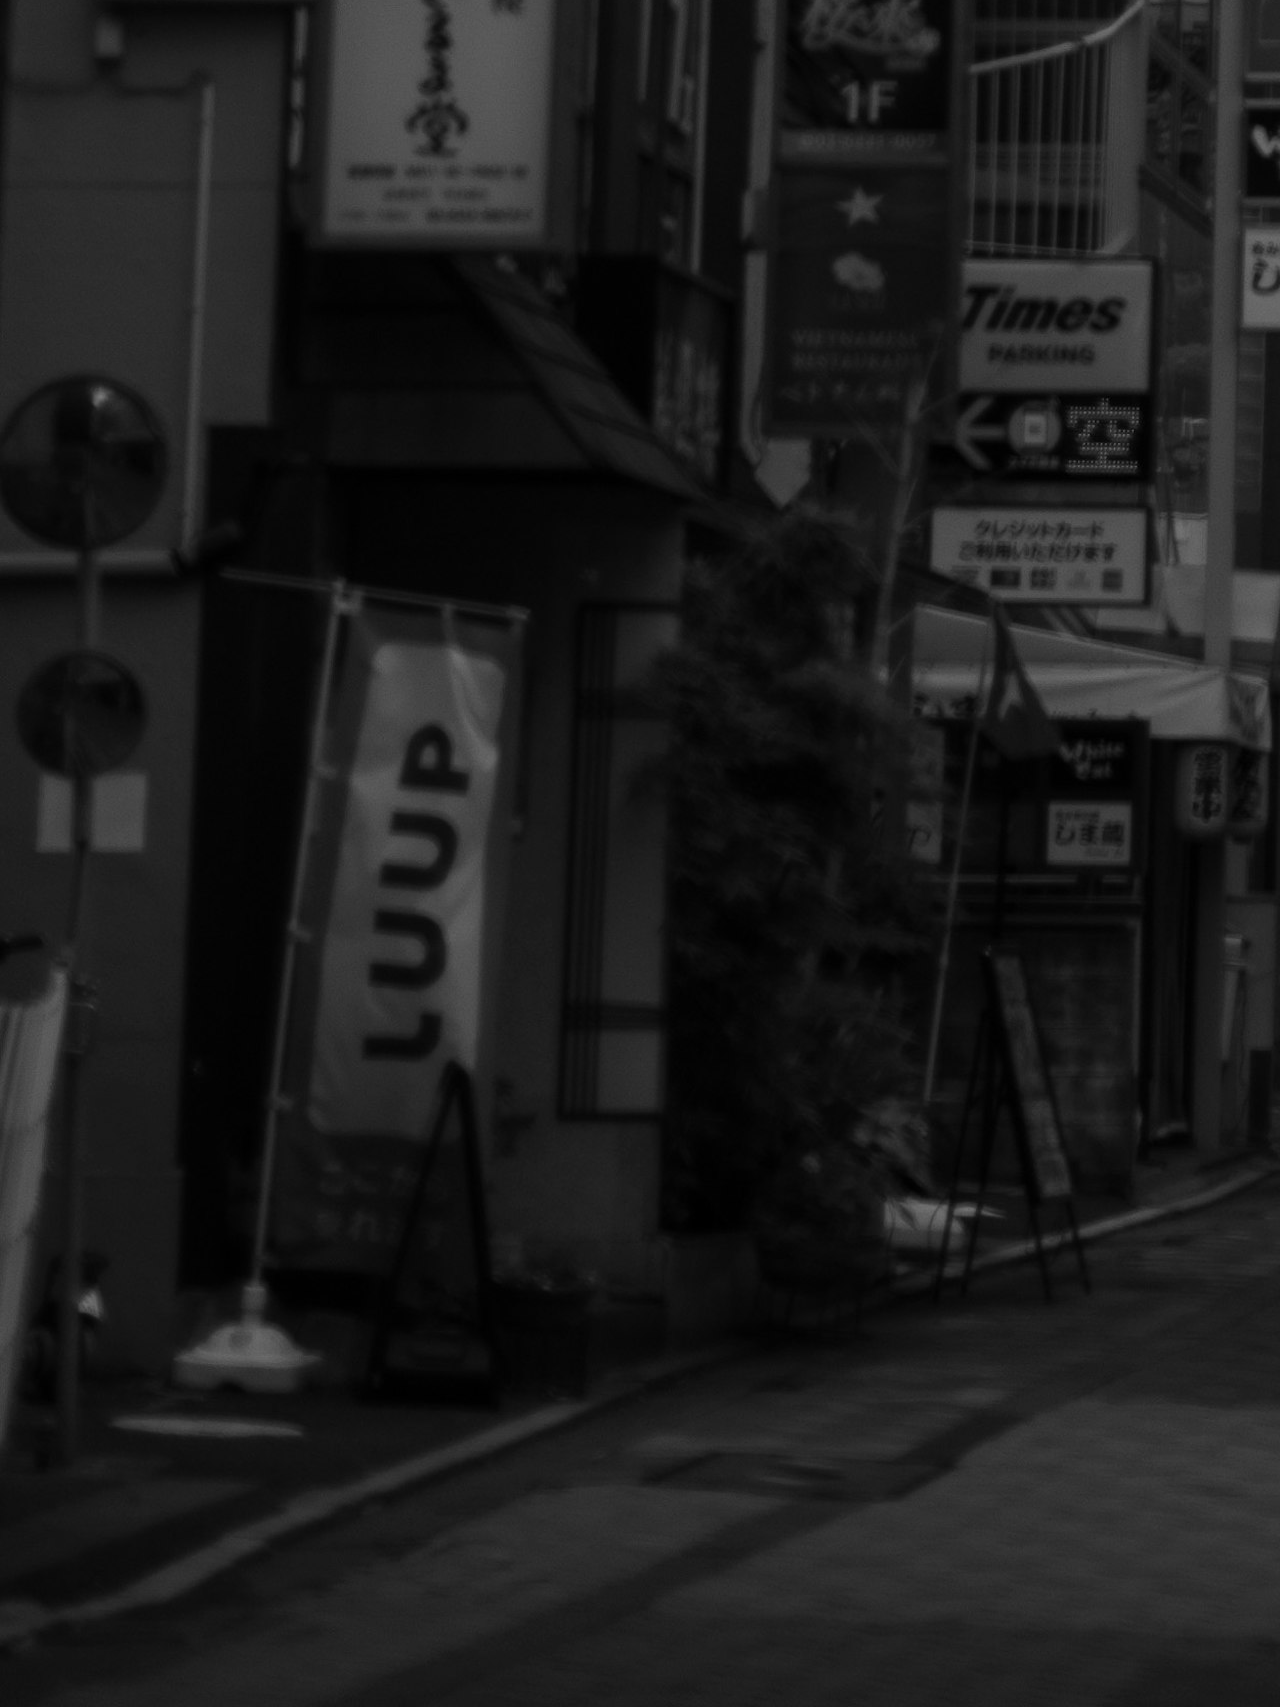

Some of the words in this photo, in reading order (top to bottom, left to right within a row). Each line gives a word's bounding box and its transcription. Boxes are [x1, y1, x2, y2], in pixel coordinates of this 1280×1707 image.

[840, 81, 898, 123] 1F
[962, 284, 1128, 335] Times
[987, 343, 1096, 365] PARKING
[1066, 397, 1140, 475] 空
[362, 720, 472, 1062] LUUP
